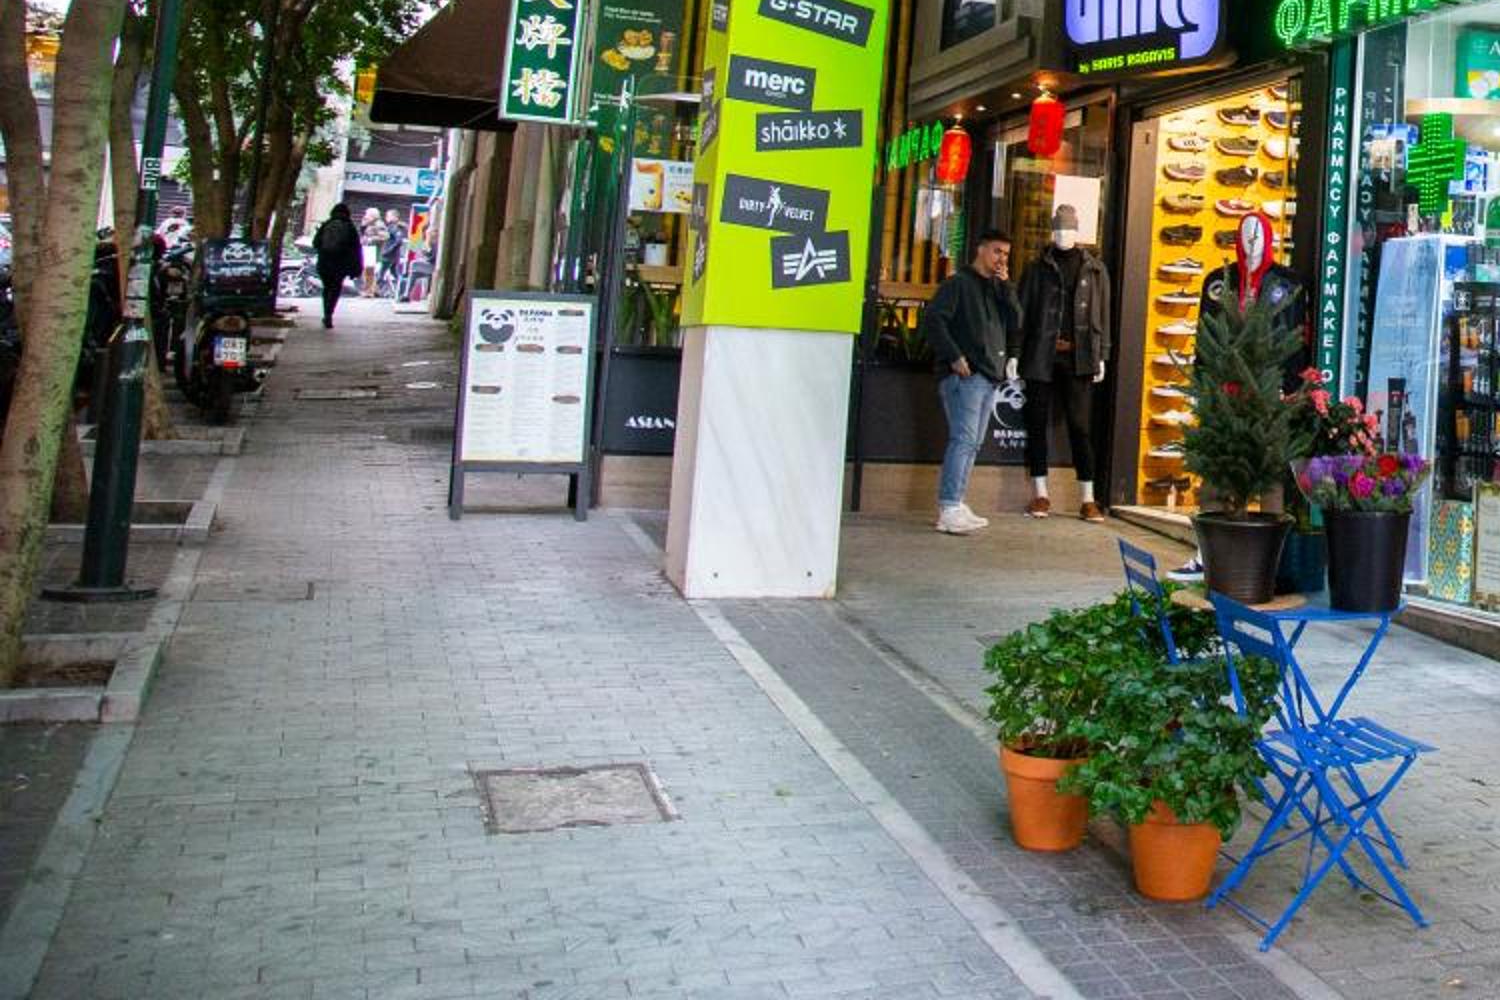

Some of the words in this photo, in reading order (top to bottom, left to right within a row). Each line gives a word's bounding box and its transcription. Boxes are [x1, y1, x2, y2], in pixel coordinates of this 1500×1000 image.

[745, 69, 806, 95] merc
[1329, 87, 1347, 219] PHARMACY
[1320, 231, 1341, 384] ΦΑΡΜΑΚΕΙΟ
[625, 415, 675, 430] ASIAN
